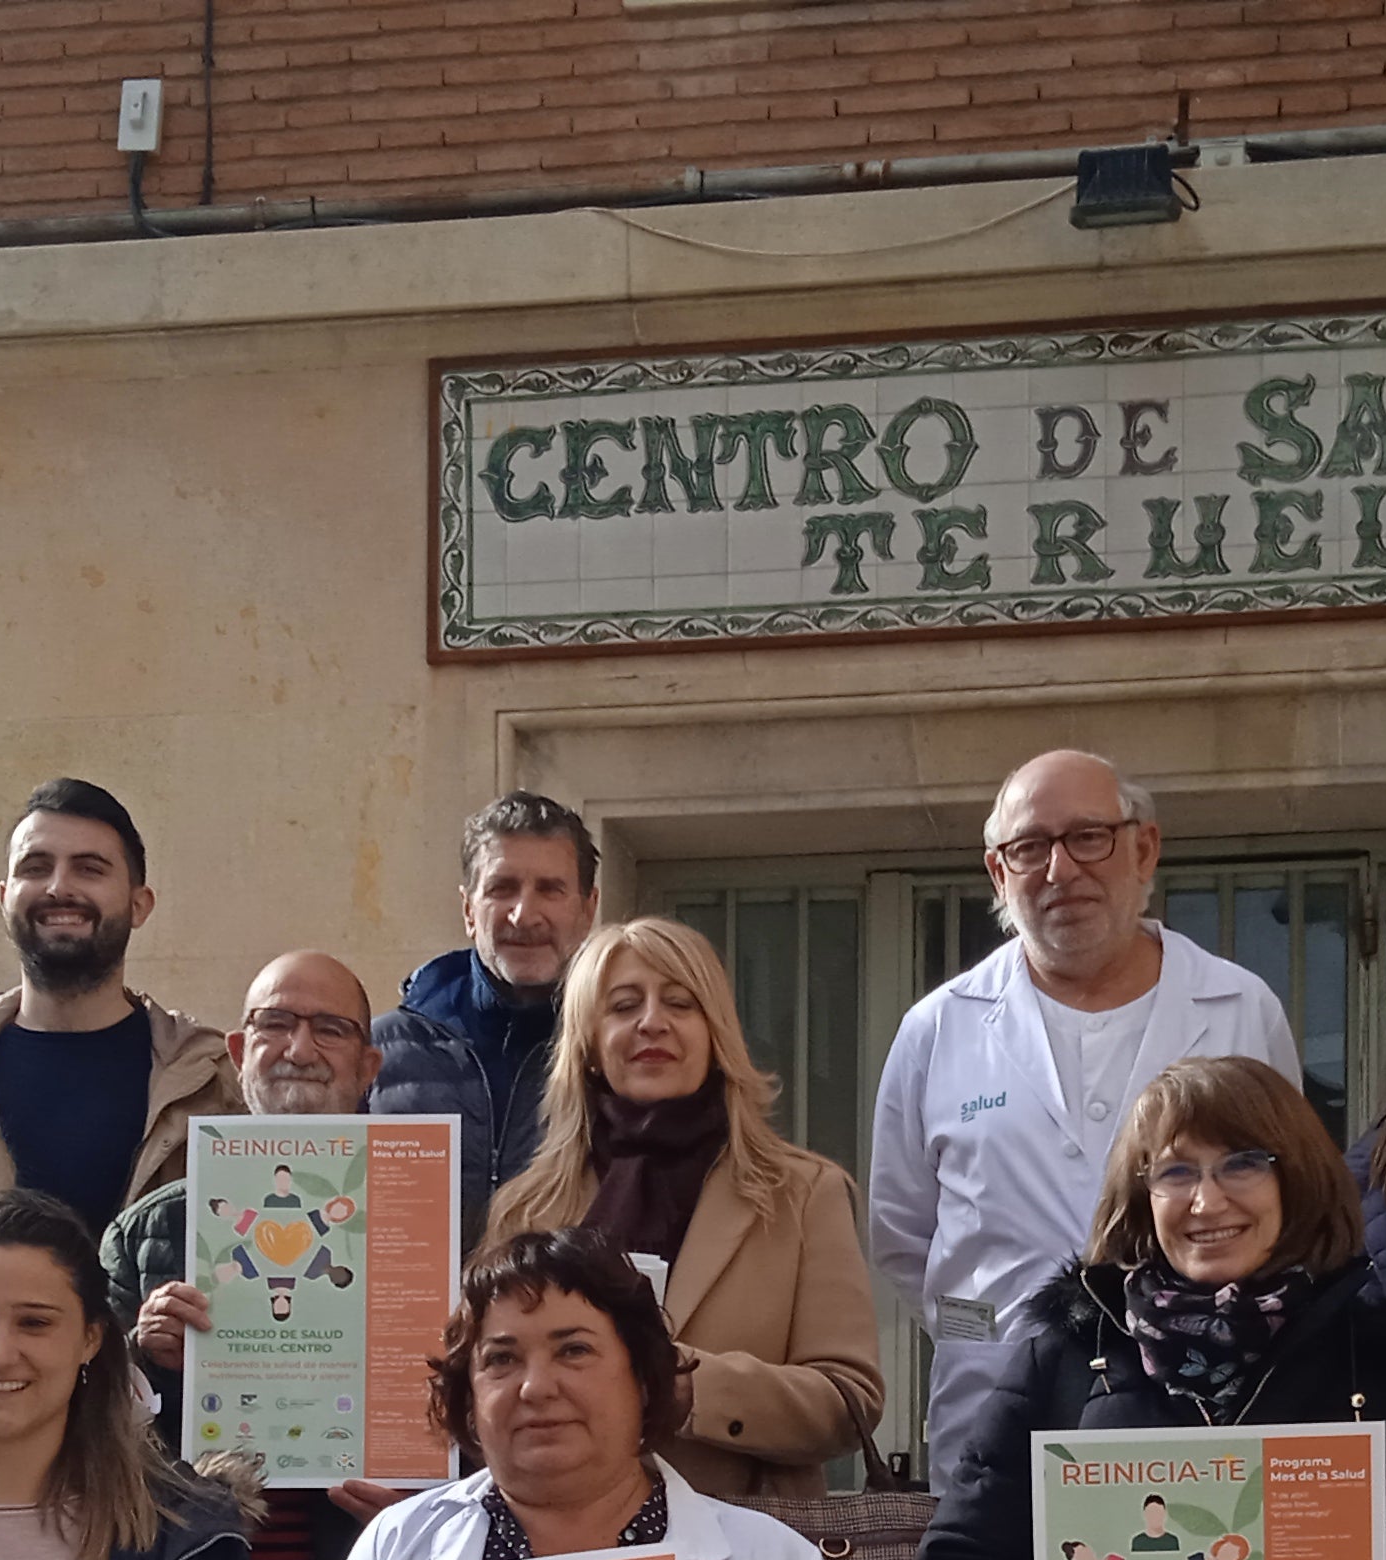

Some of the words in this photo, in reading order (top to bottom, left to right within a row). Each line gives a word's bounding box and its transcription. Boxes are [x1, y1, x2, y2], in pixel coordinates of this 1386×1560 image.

[478, 397, 979, 523] CENTRO
[1035, 400, 1177, 480] DE
[960, 1092, 1007, 1115] salud
[211, 1139, 354, 1156] REINICIA-TE
[1061, 1458, 1246, 1485] REINICIA-TE
[1270, 1455, 1331, 1469] Programa
[1270, 1471, 1295, 1481] Mes
[1298, 1470, 1313, 1480] de
[1317, 1469, 1327, 1480] la
[1330, 1468, 1365, 1479] Salud
